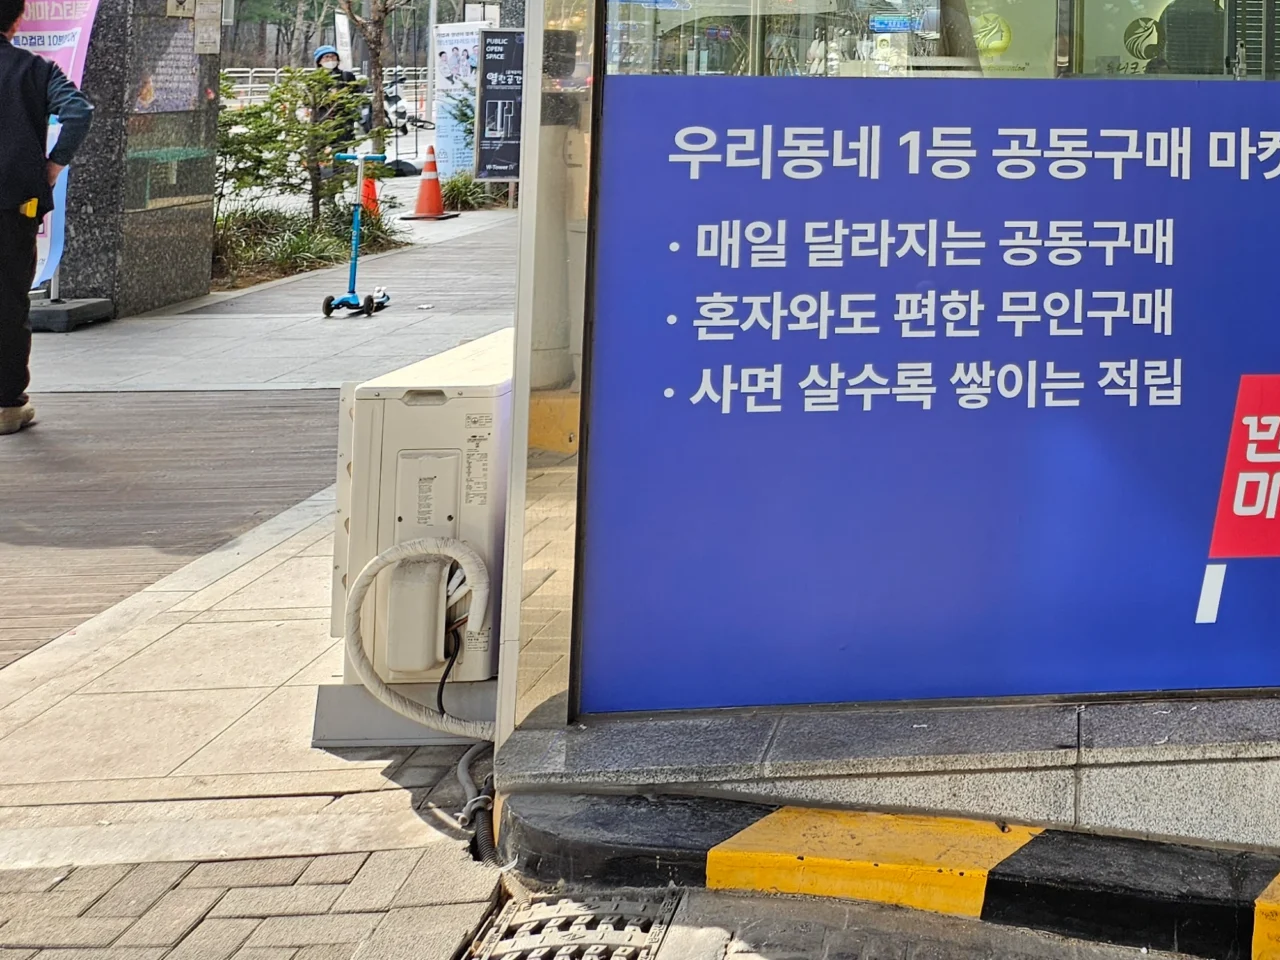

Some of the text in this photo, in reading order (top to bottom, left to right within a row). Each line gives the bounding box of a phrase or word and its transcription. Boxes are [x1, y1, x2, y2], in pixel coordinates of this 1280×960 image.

[669, 125, 880, 179] 우리동네
[900, 127, 976, 179] 1등
[992, 127, 1190, 179] 공동구매
[697, 219, 1173, 268] 매일 달라지는 공동구매
[693, 289, 1172, 340] 혼자와도 편한 무인구매
[690, 359, 1181, 414] 사면 살수록 쌓이는 적립
